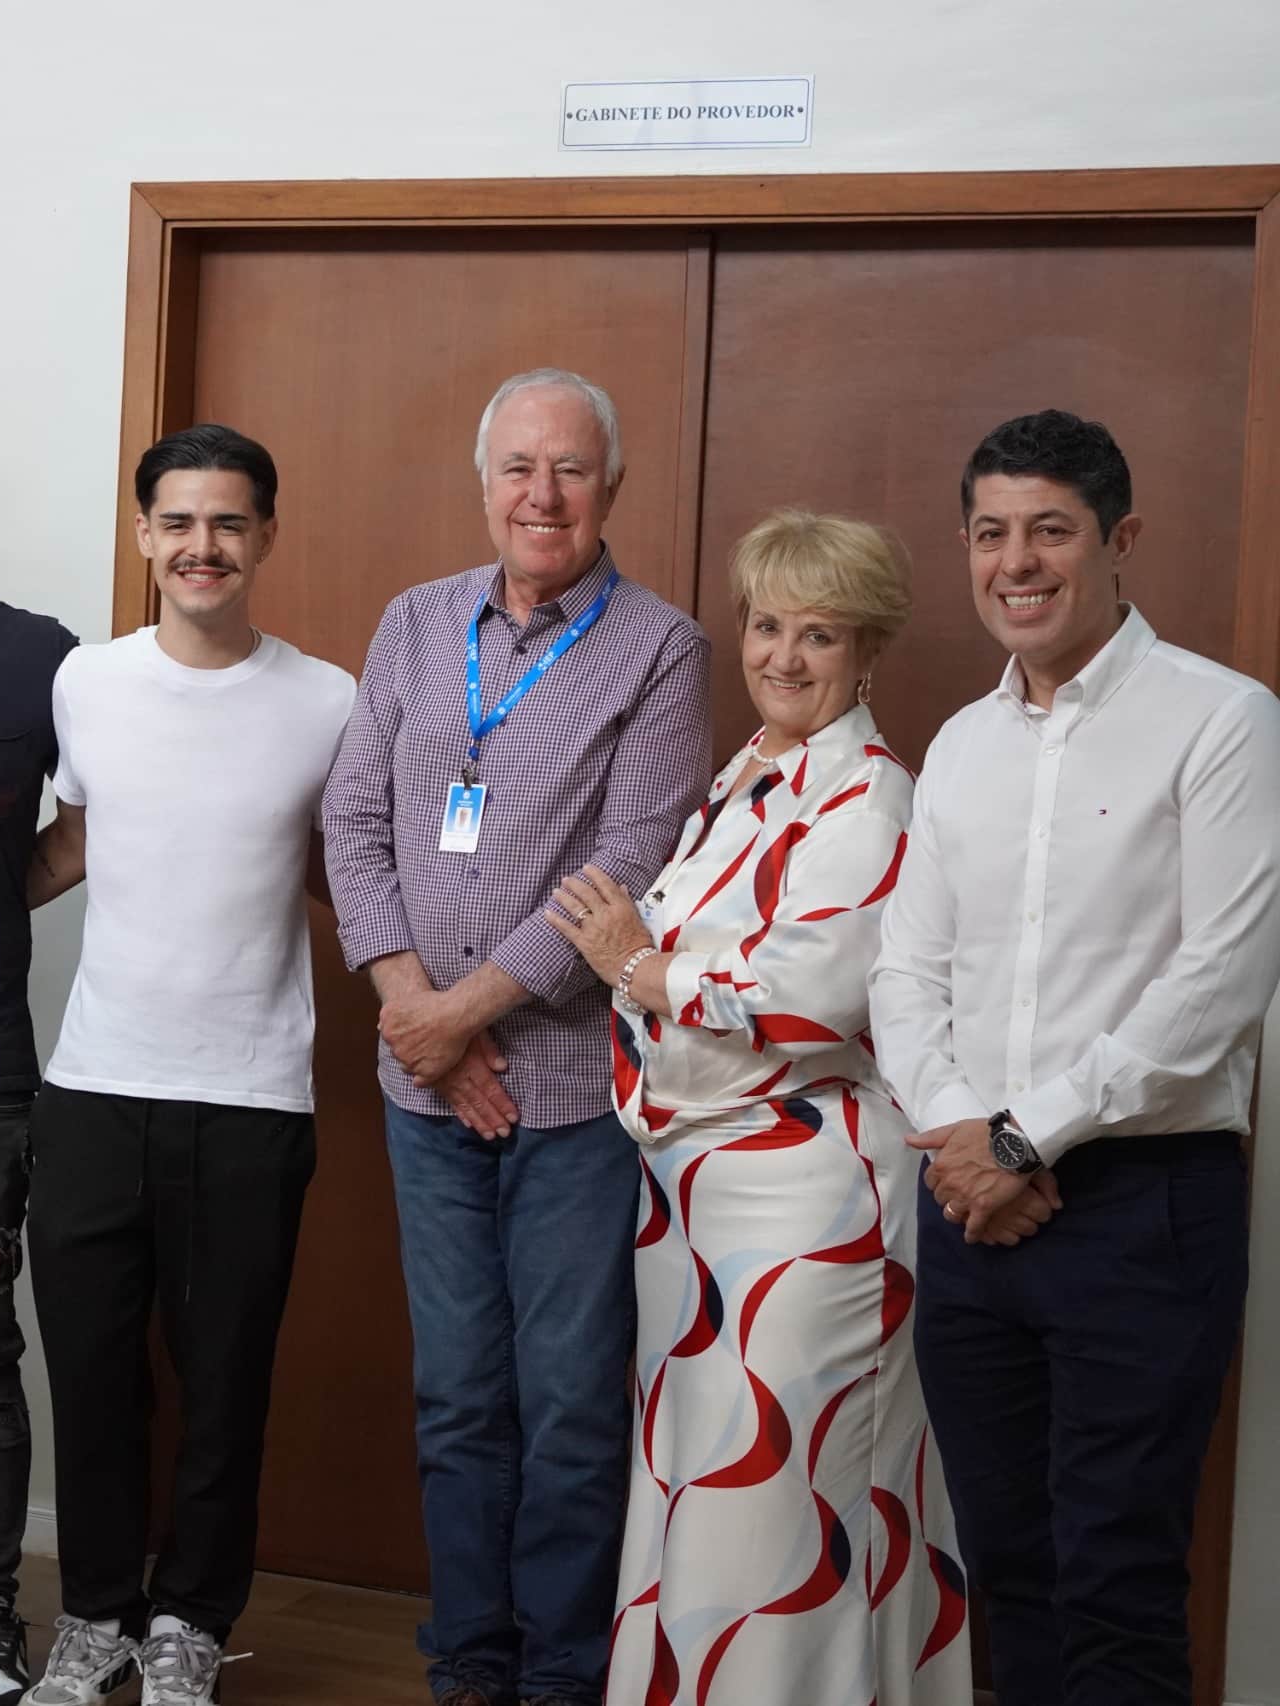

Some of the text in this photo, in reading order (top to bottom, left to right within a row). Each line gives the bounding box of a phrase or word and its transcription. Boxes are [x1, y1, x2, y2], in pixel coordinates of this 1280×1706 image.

[575, 104, 795, 122] GABINETE DO PROVEDOR
